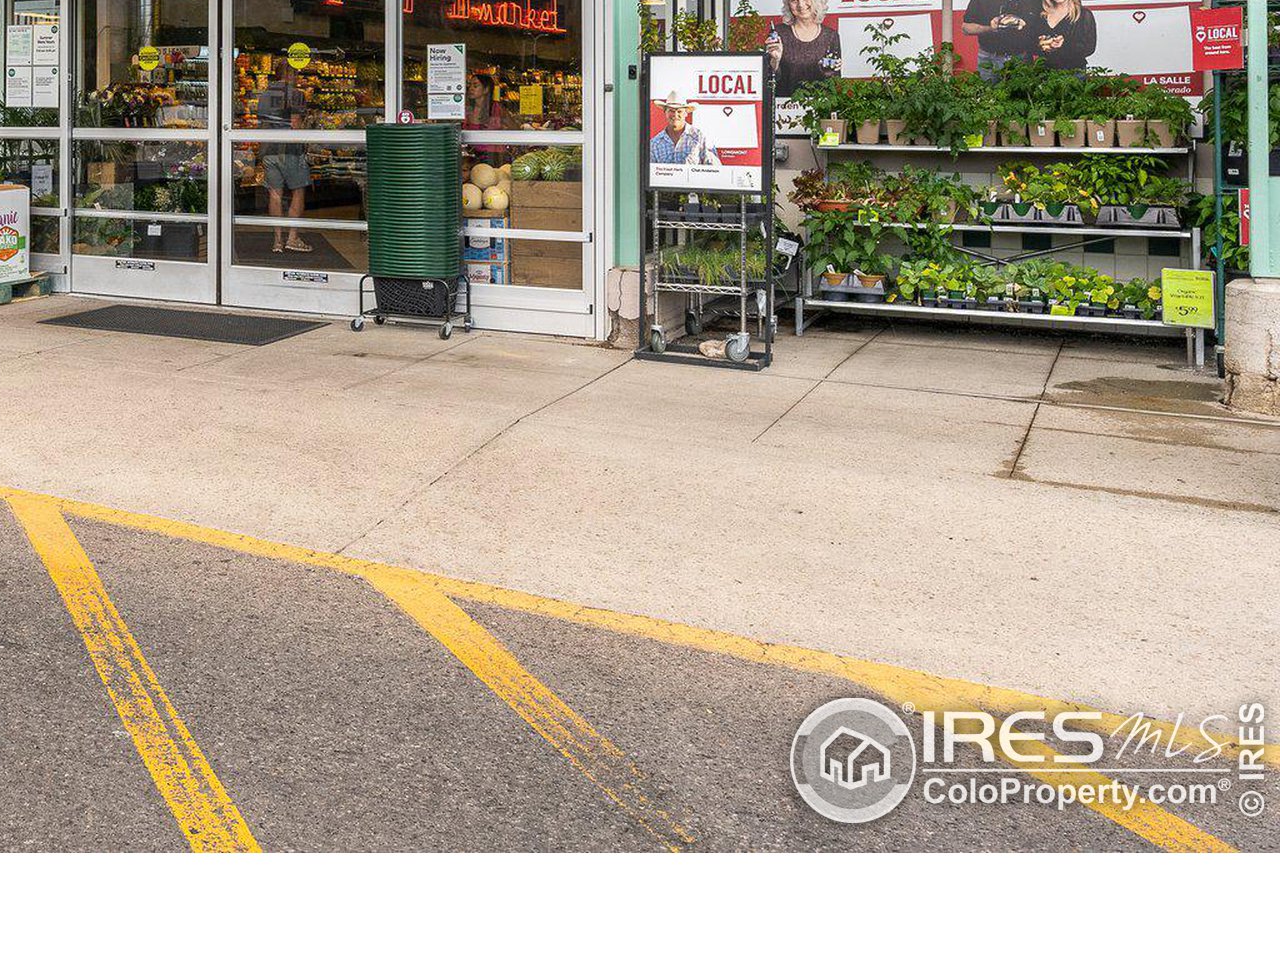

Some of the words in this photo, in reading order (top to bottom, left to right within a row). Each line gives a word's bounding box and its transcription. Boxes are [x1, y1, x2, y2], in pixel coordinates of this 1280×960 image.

[1207, 26, 1238, 40] LOCAL
[698, 74, 756, 95] LOCAL
[1143, 76, 1158, 84] LA
[1159, 76, 1191, 84] SALLE
